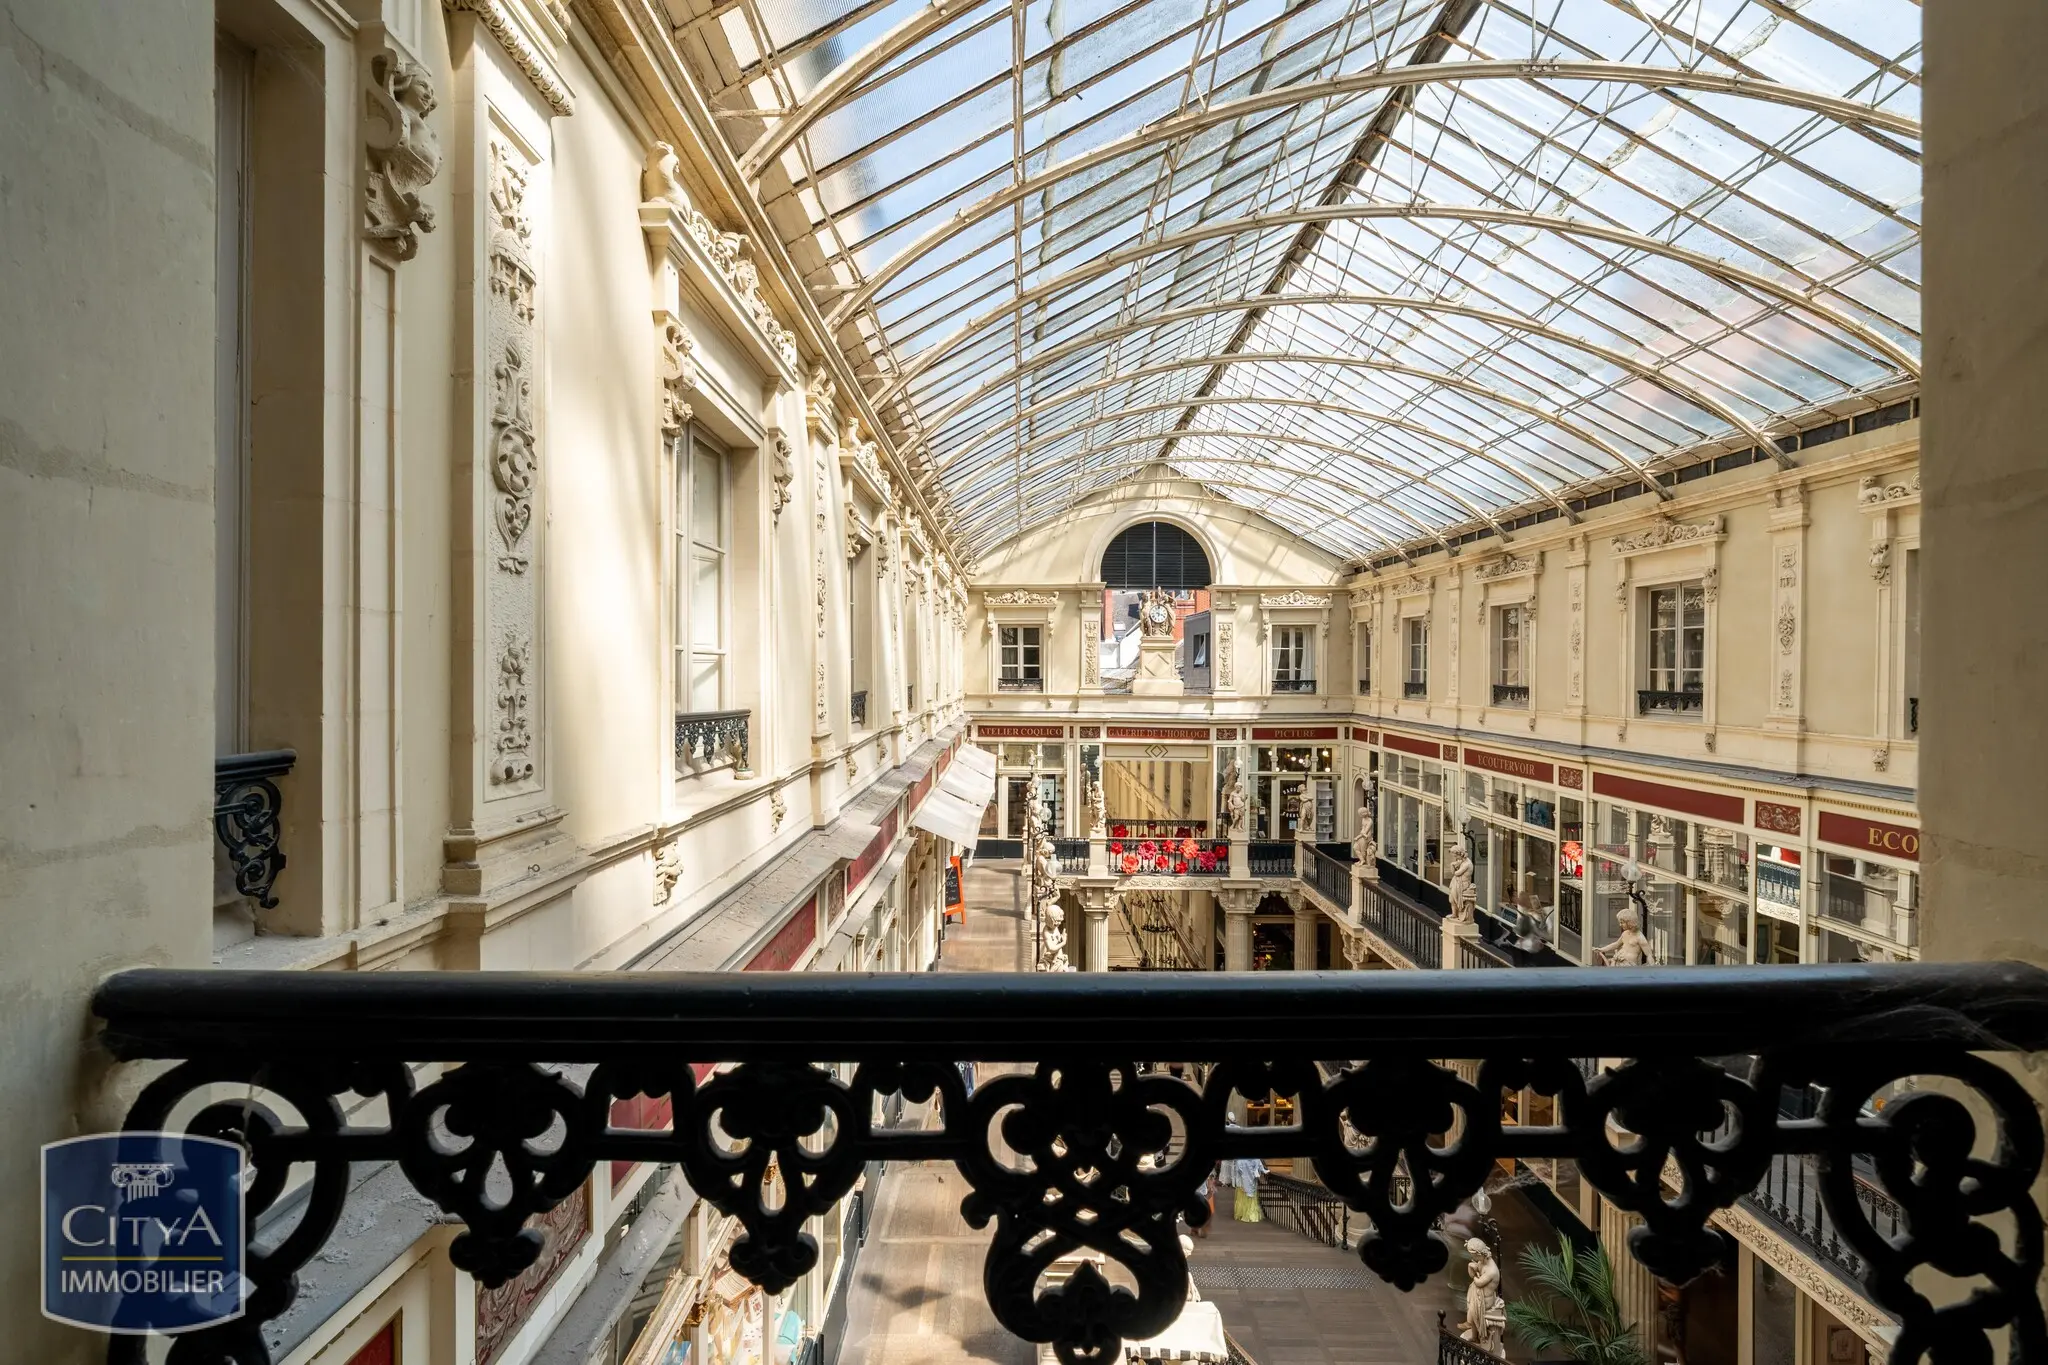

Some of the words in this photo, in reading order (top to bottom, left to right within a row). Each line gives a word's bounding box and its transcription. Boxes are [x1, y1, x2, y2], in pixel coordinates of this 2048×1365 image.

[980, 727, 1019, 736] ATELIER
[1020, 728, 1063, 737] COQLICO
[1107, 728, 1146, 738] GALERIE
[1147, 729, 1157, 738] DE
[1159, 730, 1209, 739] L'HORLOGE
[1274, 729, 1316, 738] PICTURE
[1477, 754, 1535, 776] ECOUTERVOIR
